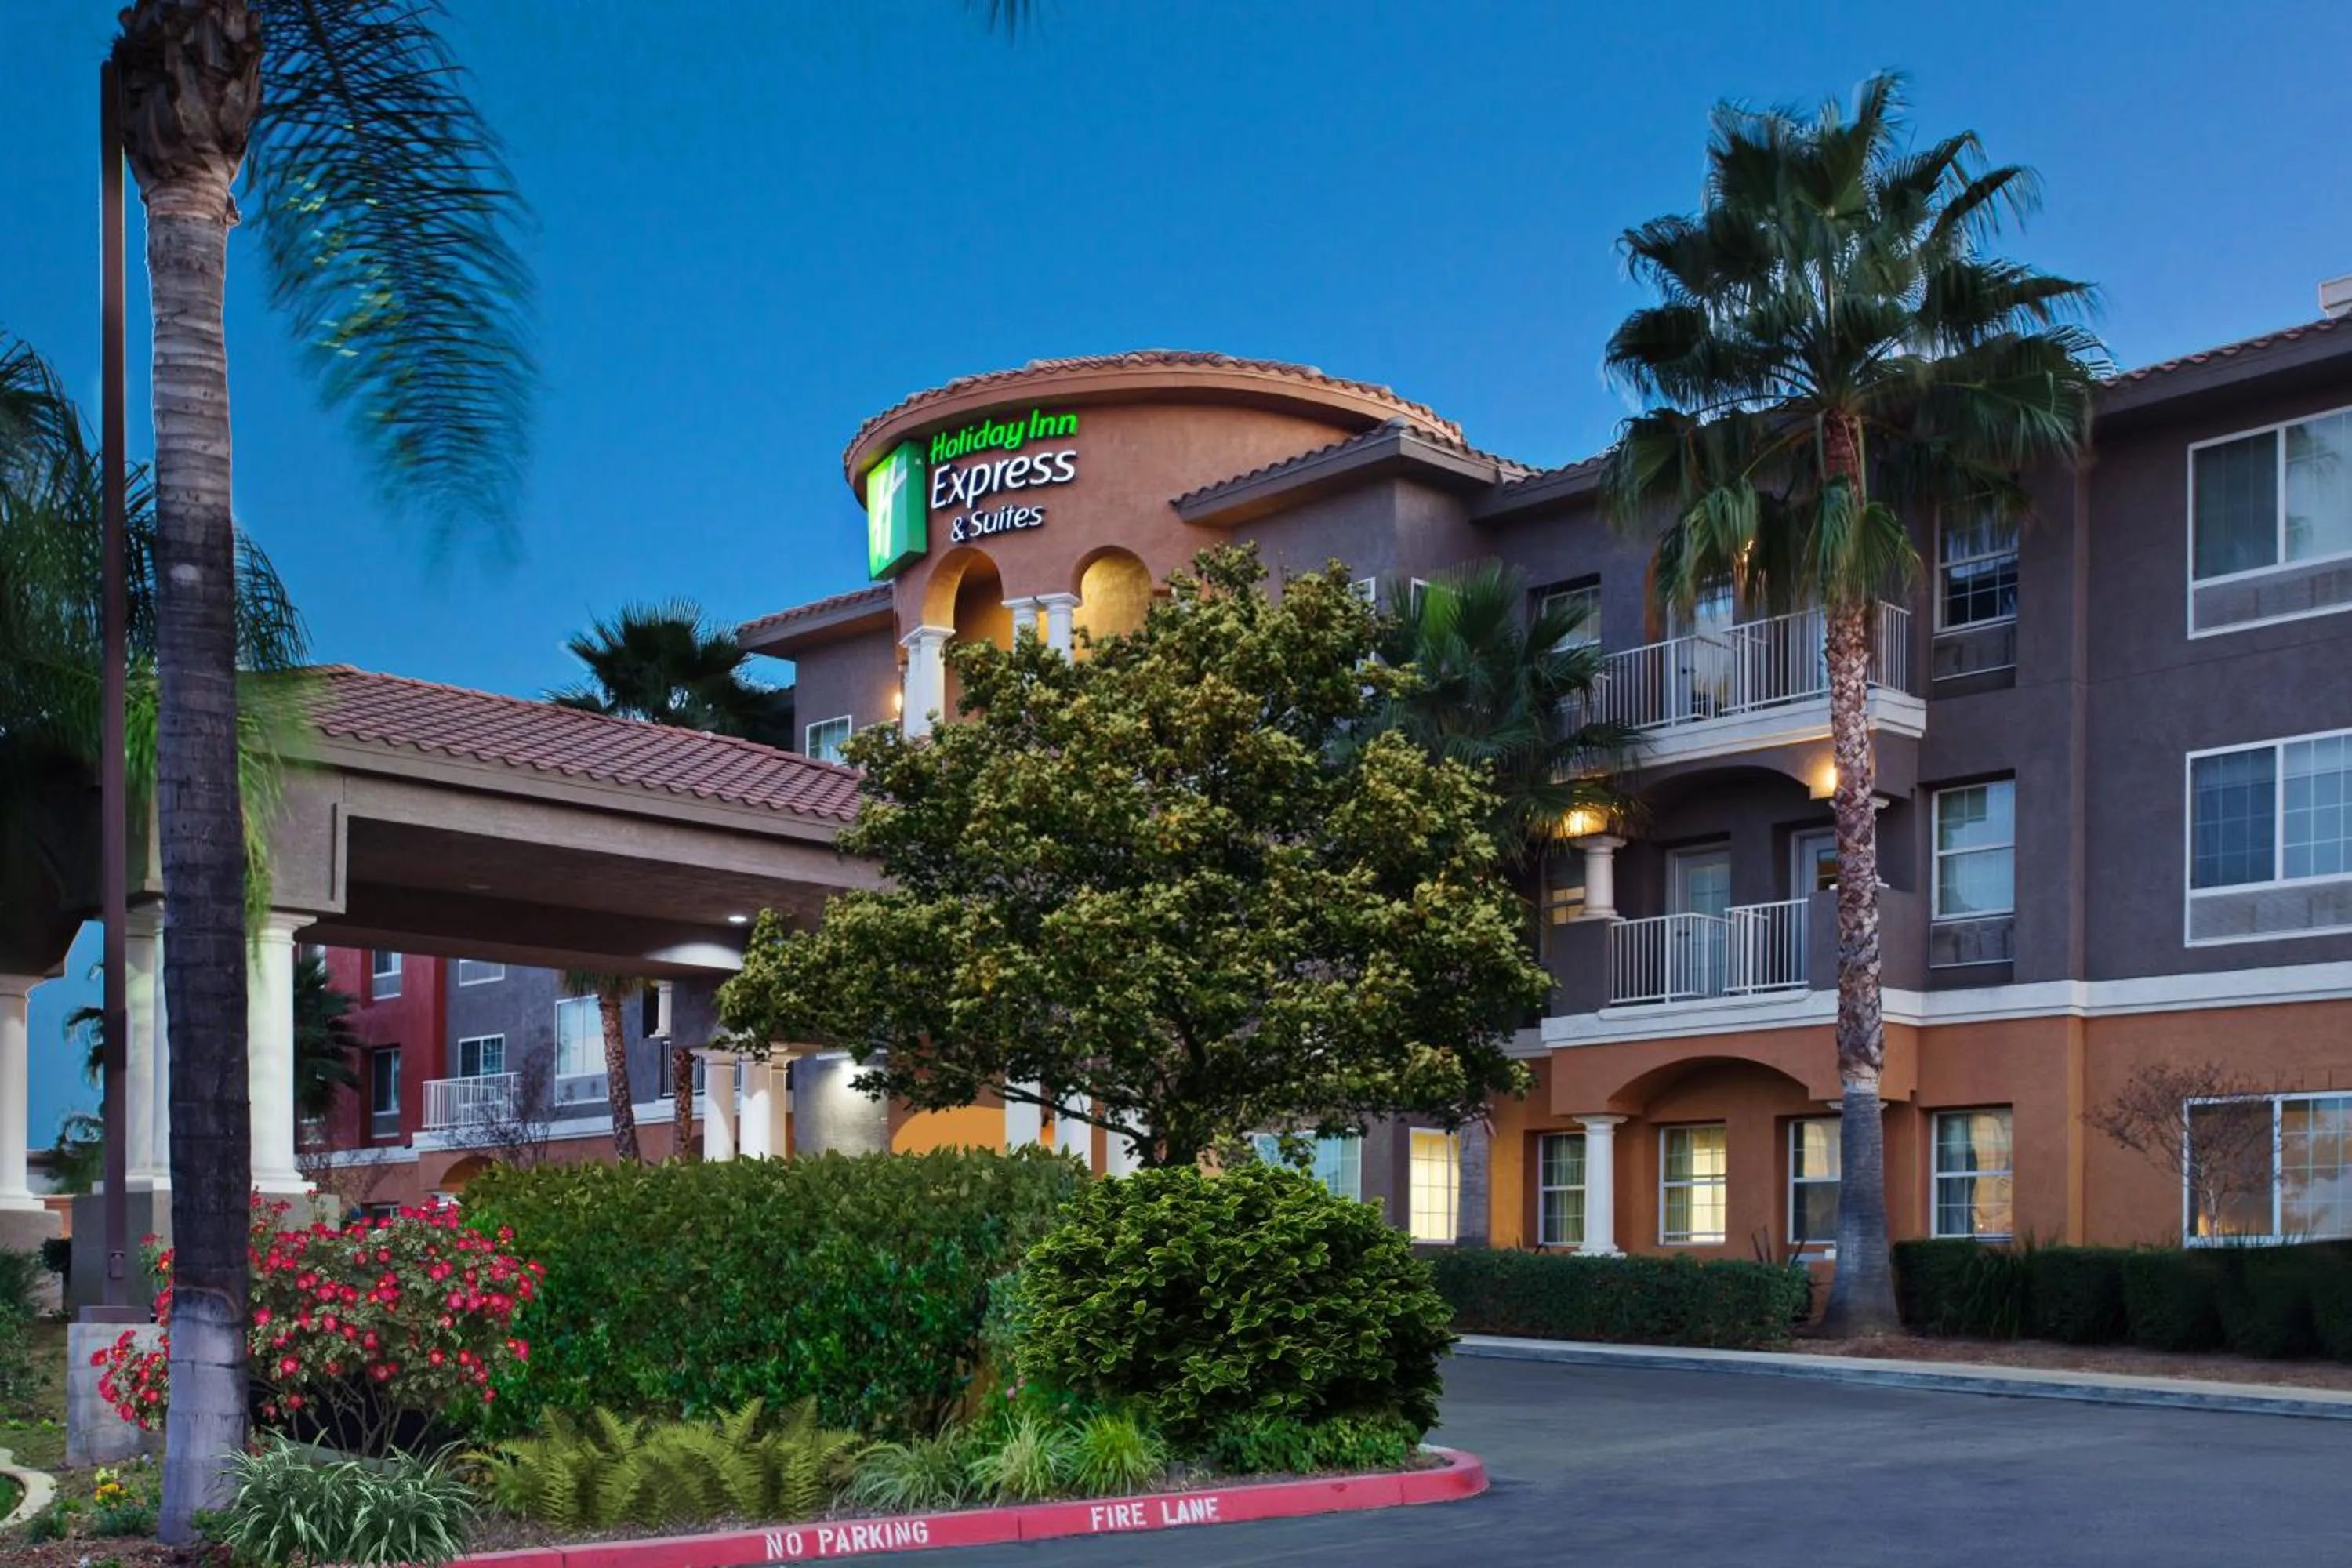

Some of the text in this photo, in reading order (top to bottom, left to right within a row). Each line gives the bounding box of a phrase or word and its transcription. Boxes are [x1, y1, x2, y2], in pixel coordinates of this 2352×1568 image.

[931, 409, 1077, 464] Holiday Inn
[931, 450, 1076, 508] Express
[950, 504, 1043, 542] & Suites
[1091, 1498, 1219, 1530] FIRE LANE
[766, 1521, 928, 1559] NO PARKING
